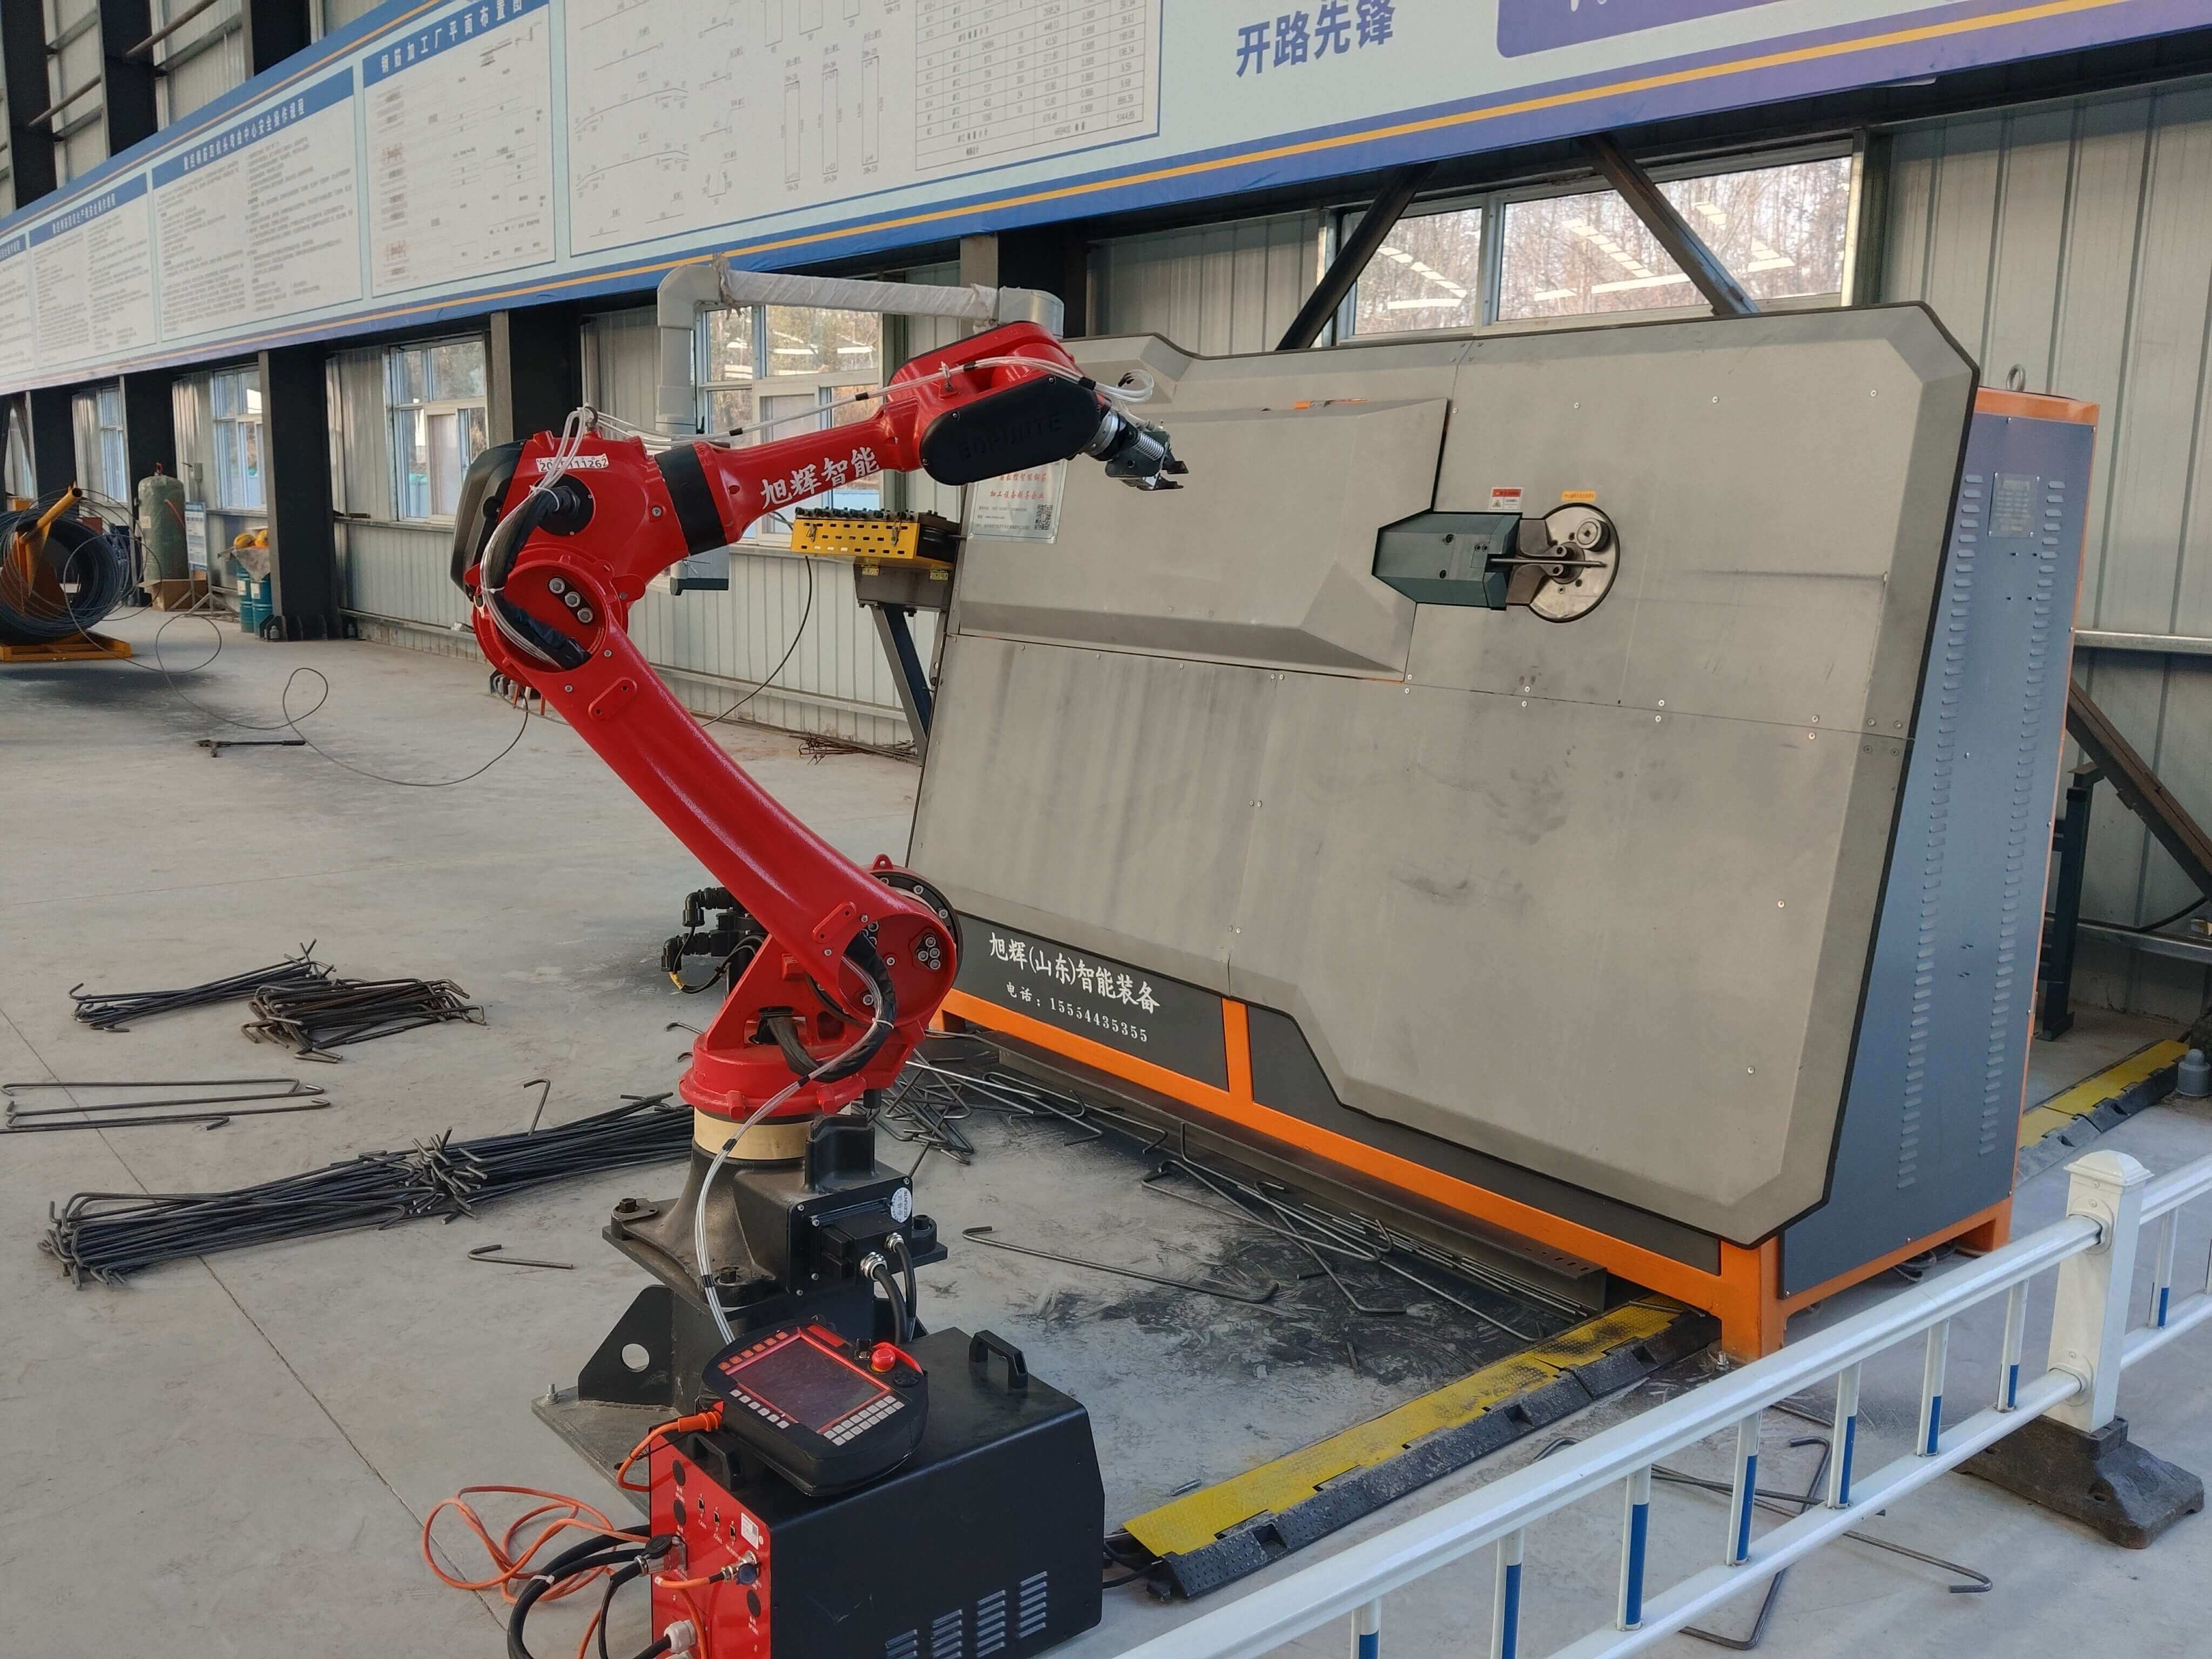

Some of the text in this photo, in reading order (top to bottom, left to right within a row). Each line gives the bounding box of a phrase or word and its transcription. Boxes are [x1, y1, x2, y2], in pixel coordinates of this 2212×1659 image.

[381, 0, 522, 73] 钢筋加工厂平面布置图
[1236, 0, 1395, 77] 开路先锋
[540, 458, 608, 471] 20111262
[760, 447, 880, 510] 旭辉智能
[989, 932, 1161, 1014] 旭辉(山东)智能装备
[1050, 997, 1148, 1042] 15554435355
